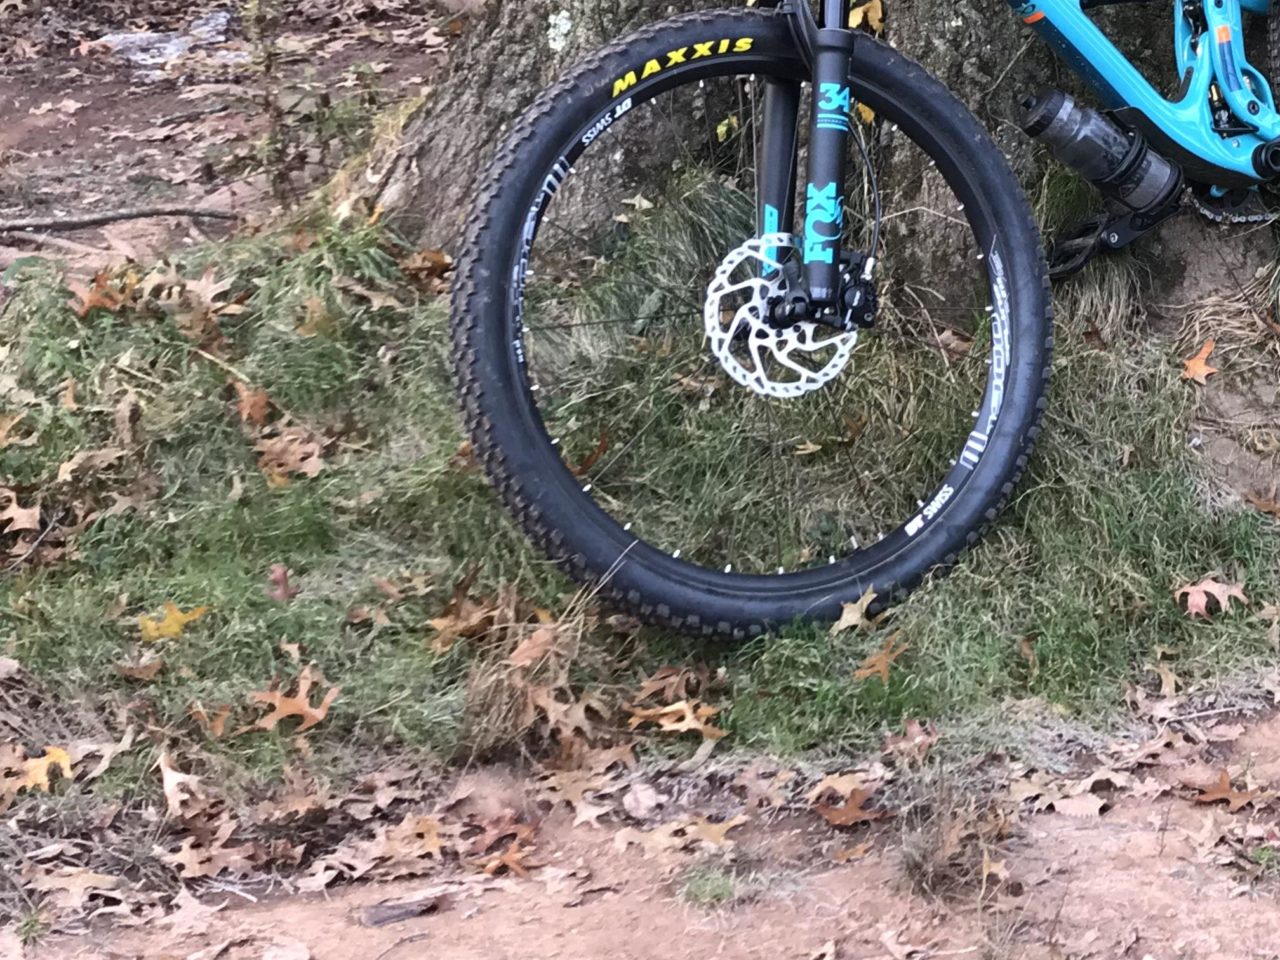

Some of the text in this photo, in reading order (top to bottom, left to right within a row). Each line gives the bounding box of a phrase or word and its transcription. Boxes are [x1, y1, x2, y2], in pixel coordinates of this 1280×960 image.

[612, 38, 754, 98] MAXXIS
[818, 82, 850, 113] 34
[582, 112, 613, 146] SWISS
[803, 182, 844, 265] FOX
